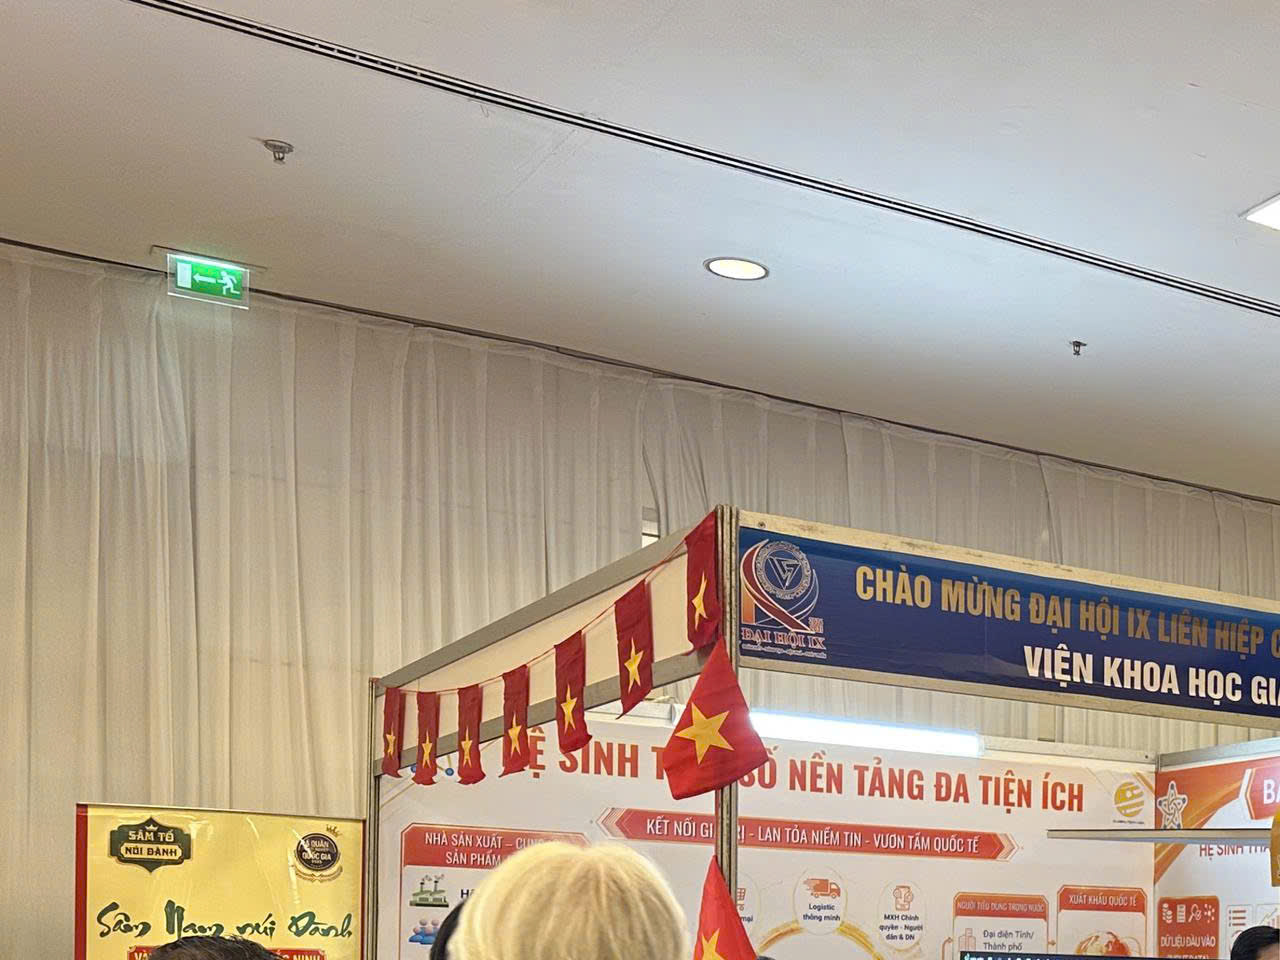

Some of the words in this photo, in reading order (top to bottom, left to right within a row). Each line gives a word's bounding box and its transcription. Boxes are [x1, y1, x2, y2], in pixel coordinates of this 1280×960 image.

[855, 565, 931, 609] CHÀO
[941, 578, 1020, 621] MỪNG
[1029, 593, 1071, 634] ĐẠI
[1079, 597, 1119, 640] HỘI
[1127, 608, 1150, 640] IX
[1158, 609, 1208, 648] LIÊN
[1215, 617, 1265, 660] HIỆP
[808, 636, 826, 650] IX
[1024, 644, 1093, 688] VIỆN
[1103, 655, 1180, 697] KHOA
[1188, 667, 1242, 705] HỌC
[559, 739, 639, 779] SINH
[789, 750, 844, 794] NỀN
[853, 756, 925, 801] TẢNG
[933, 773, 969, 804] ĐA
[979, 769, 1032, 814] TIỆN
[1041, 771, 1084, 812] ÍCH
[646, 813, 670, 836] KẾT
[673, 814, 697, 837] NỐI
[128, 830, 154, 842] SÂM
[158, 828, 175, 842] TỐ
[425, 829, 448, 845] NHÀ
[451, 830, 473, 847] SẢN
[475, 831, 503, 849] XUẤT
[757, 827, 780, 844] LAN
[784, 825, 808, 846] TỎA
[811, 826, 840, 848] NIỀM
[843, 831, 862, 848] TIN
[873, 832, 905, 850] VƯƠN
[908, 832, 931, 852] TẦM
[933, 834, 964, 855] QUỐC
[967, 834, 980, 853] TẾ
[124, 844, 146, 856] NÚI
[445, 848, 467, 864] SẢN
[809, 903, 835, 912] Logistic
[1069, 894, 1087, 904] XUẤT
[1109, 894, 1128, 907] QUỐC
[1129, 894, 1137, 906] TẾ
[97, 901, 151, 938] Sâm
[803, 914, 822, 922] thông
[824, 914, 840, 922] minh
[983, 930, 997, 939] Đại
[998, 930, 1013, 939] diện
[1200, 935, 1216, 948] VÀO
[983, 941, 1007, 950] Thành
